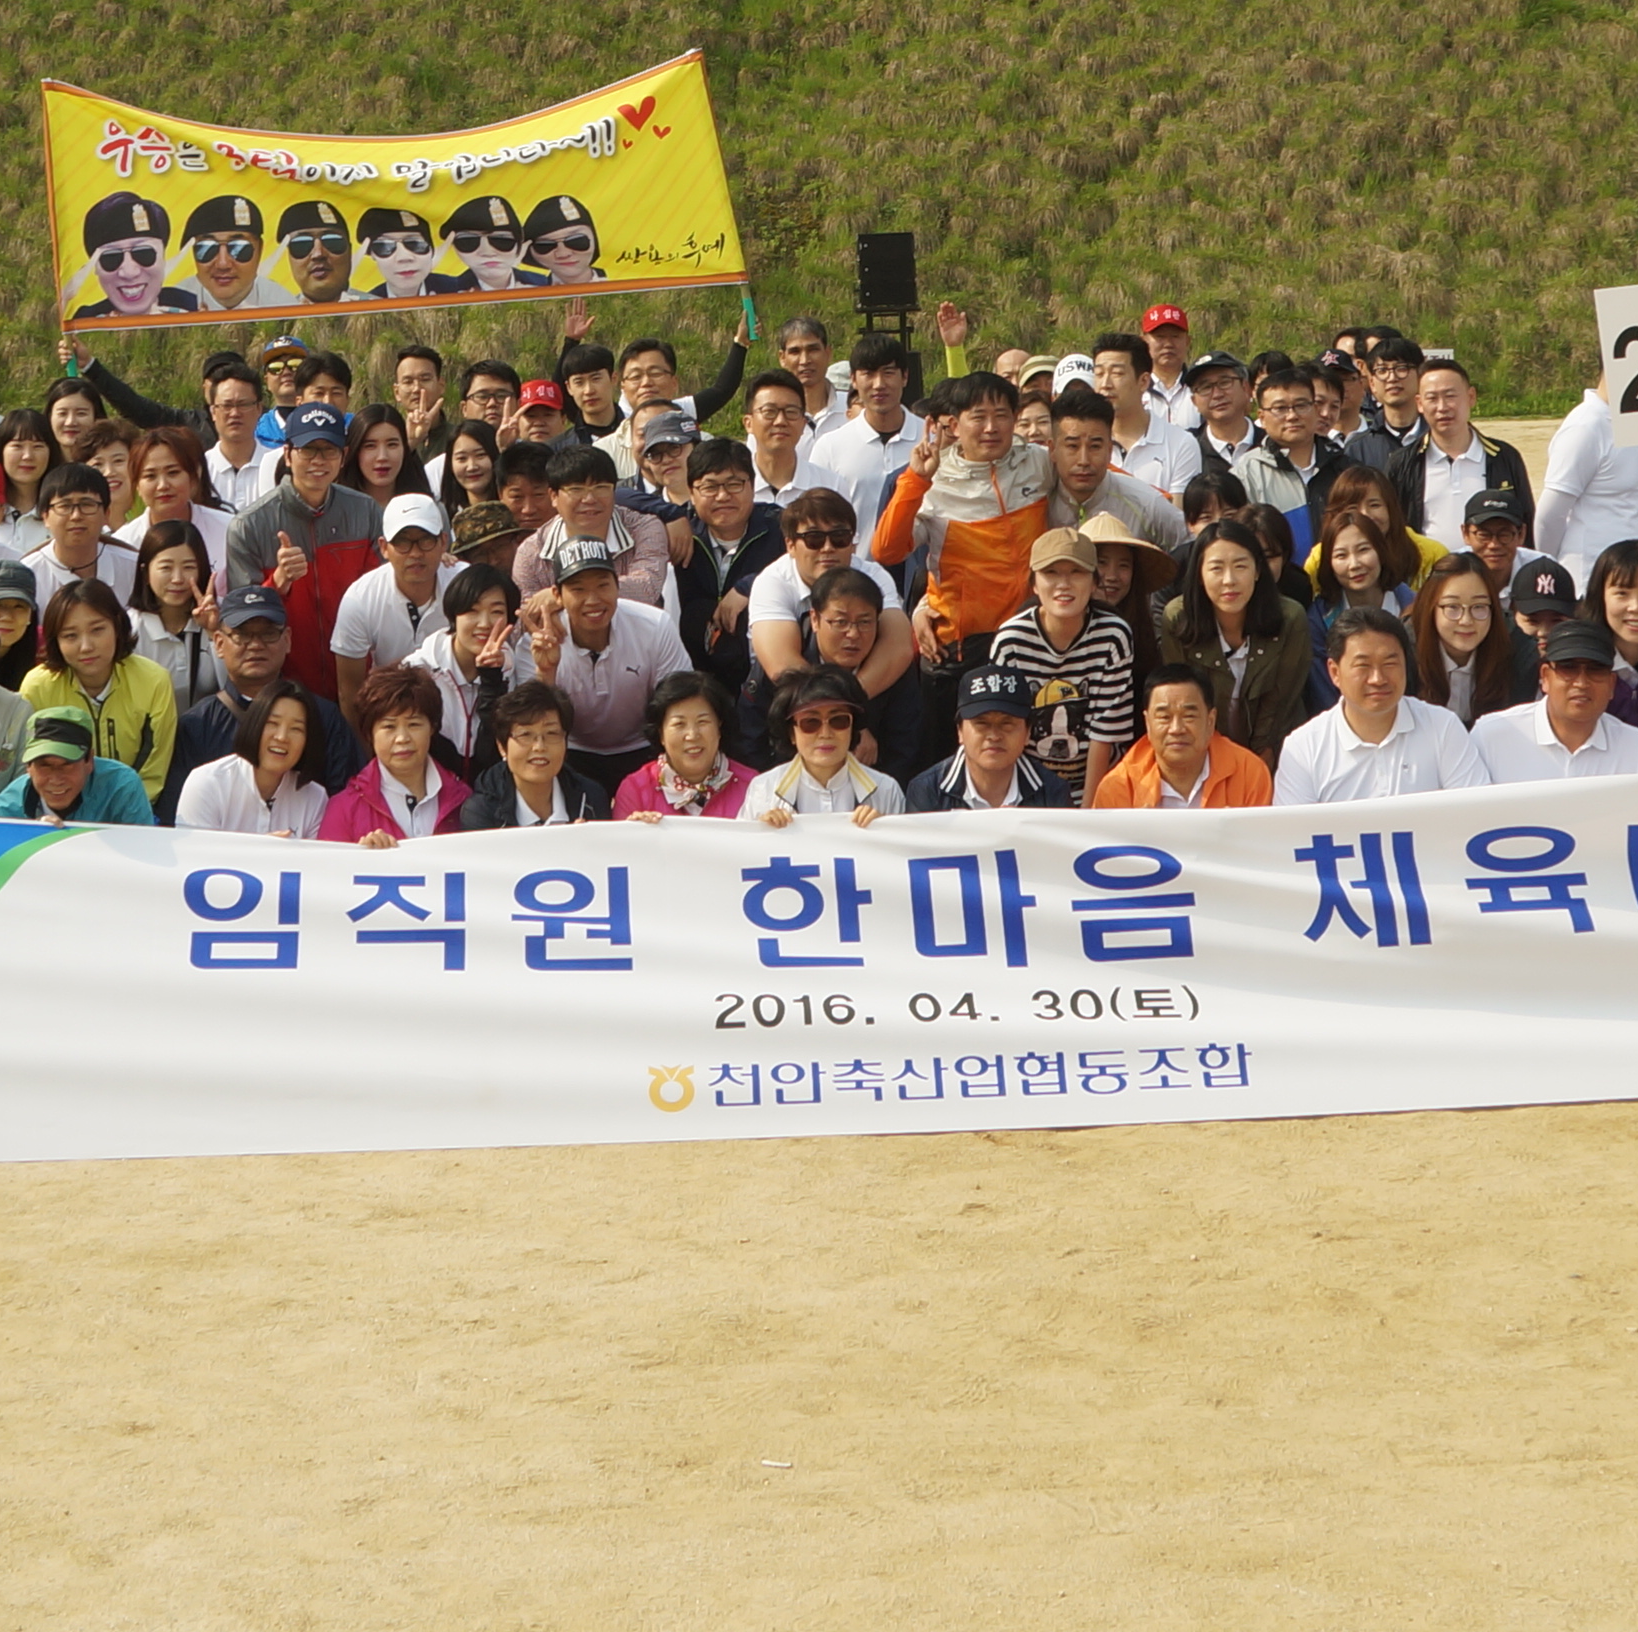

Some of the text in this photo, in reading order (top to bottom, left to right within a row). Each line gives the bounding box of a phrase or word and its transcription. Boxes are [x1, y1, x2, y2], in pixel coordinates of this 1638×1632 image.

[98, 120, 209, 176] 우승은
[682, 230, 726, 269] 후예
[558, 540, 608, 570] DETROIT
[1536, 573, 1556, 596] NY
[969, 673, 1018, 695] 조합장
[183, 865, 634, 971] 임직원
[741, 844, 1195, 968] 한마음
[714, 984, 1202, 1030] 2016. 04. 30(토)
[707, 1042, 1253, 1108] 천안축산업협동조합
